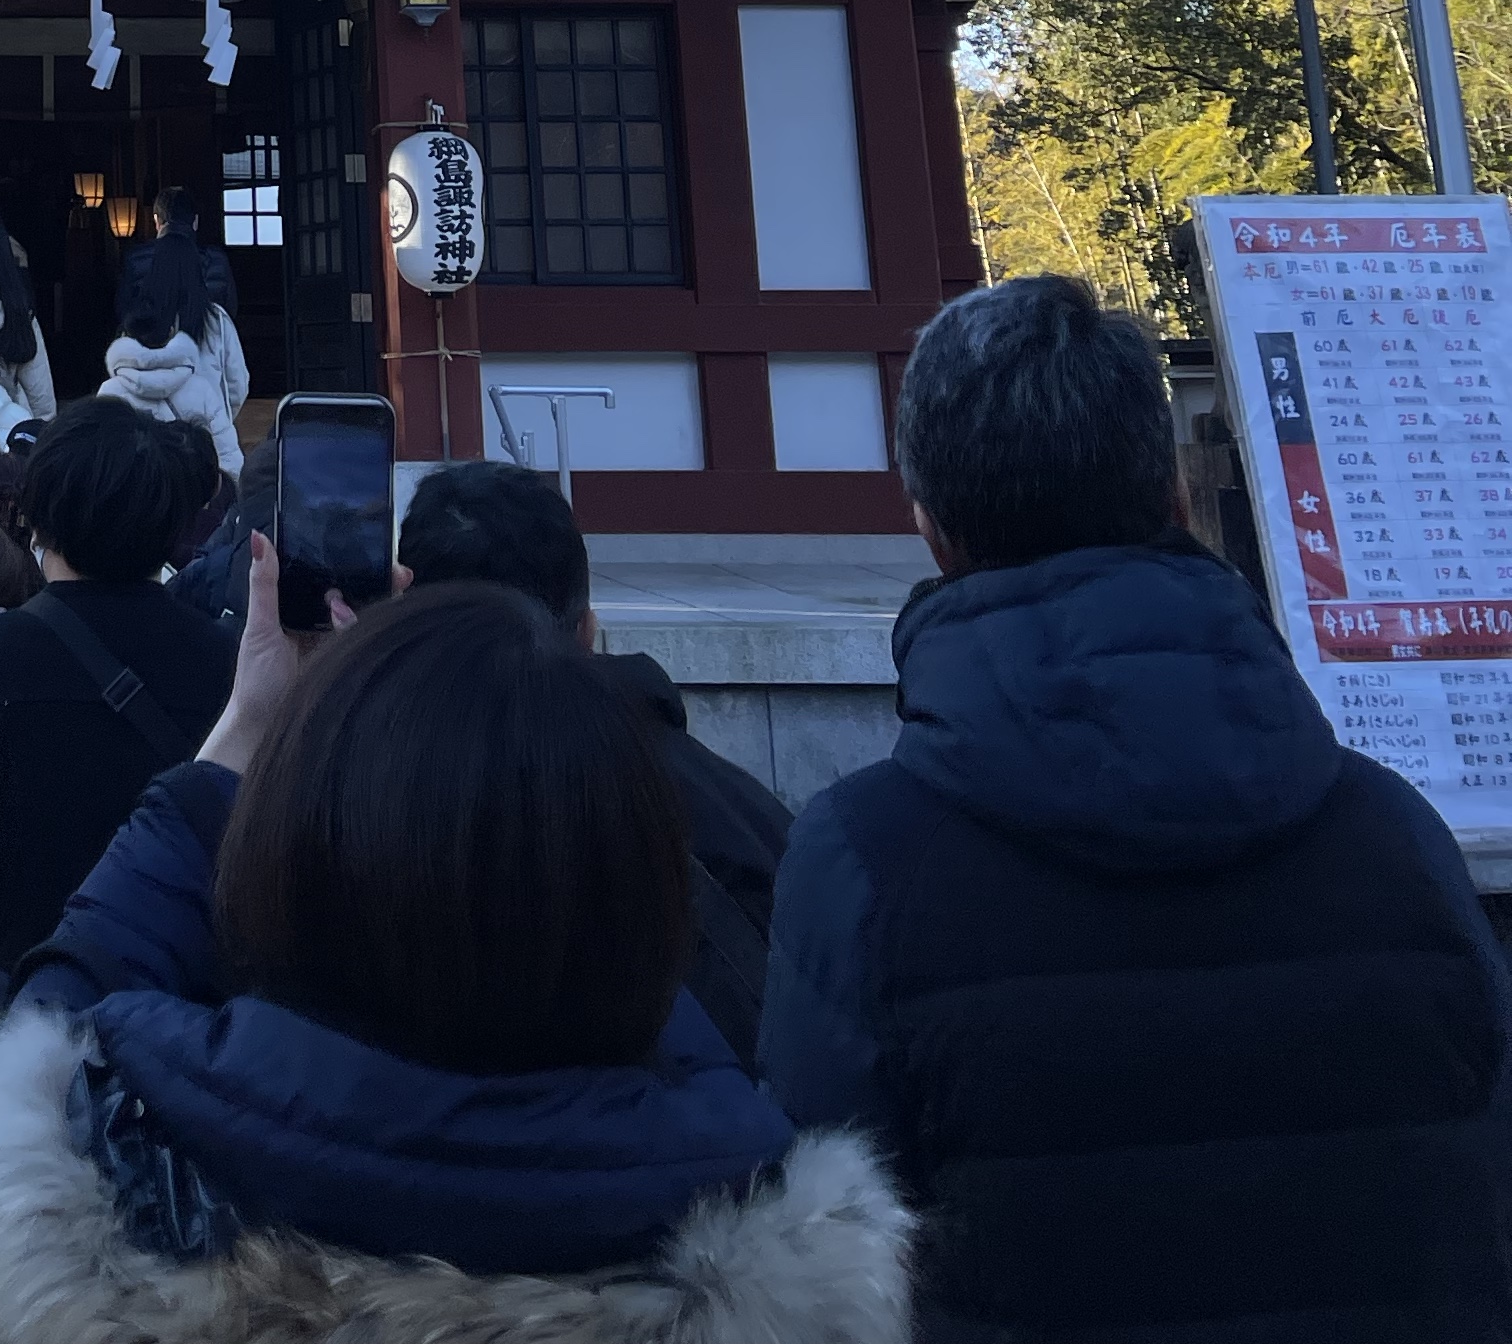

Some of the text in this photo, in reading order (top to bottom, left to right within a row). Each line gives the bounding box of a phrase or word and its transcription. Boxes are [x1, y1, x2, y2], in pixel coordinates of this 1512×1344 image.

[427, 137, 476, 284] 綱島諏訪神社
[1235, 222, 1482, 248] 令和4年 厄年表
[1269, 358, 1300, 419] 男性
[1297, 490, 1331, 554] 女性
